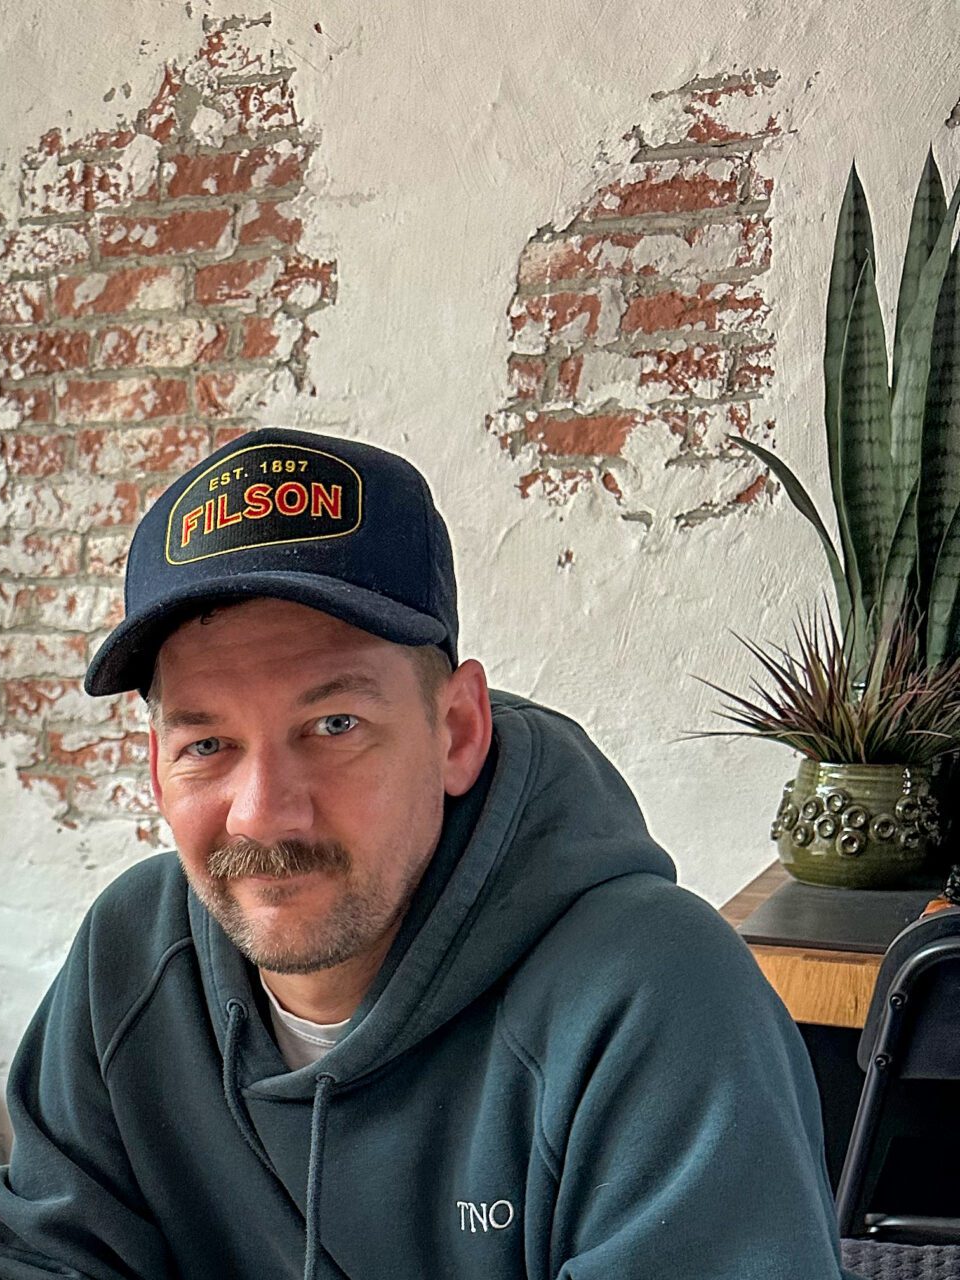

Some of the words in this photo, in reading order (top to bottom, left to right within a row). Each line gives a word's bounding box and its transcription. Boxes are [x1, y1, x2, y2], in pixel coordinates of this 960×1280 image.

[208, 466, 249, 492] EST.
[260, 460, 309, 474] 1897
[180, 481, 343, 548] FILSON
[456, 1199, 514, 1232] TNO
